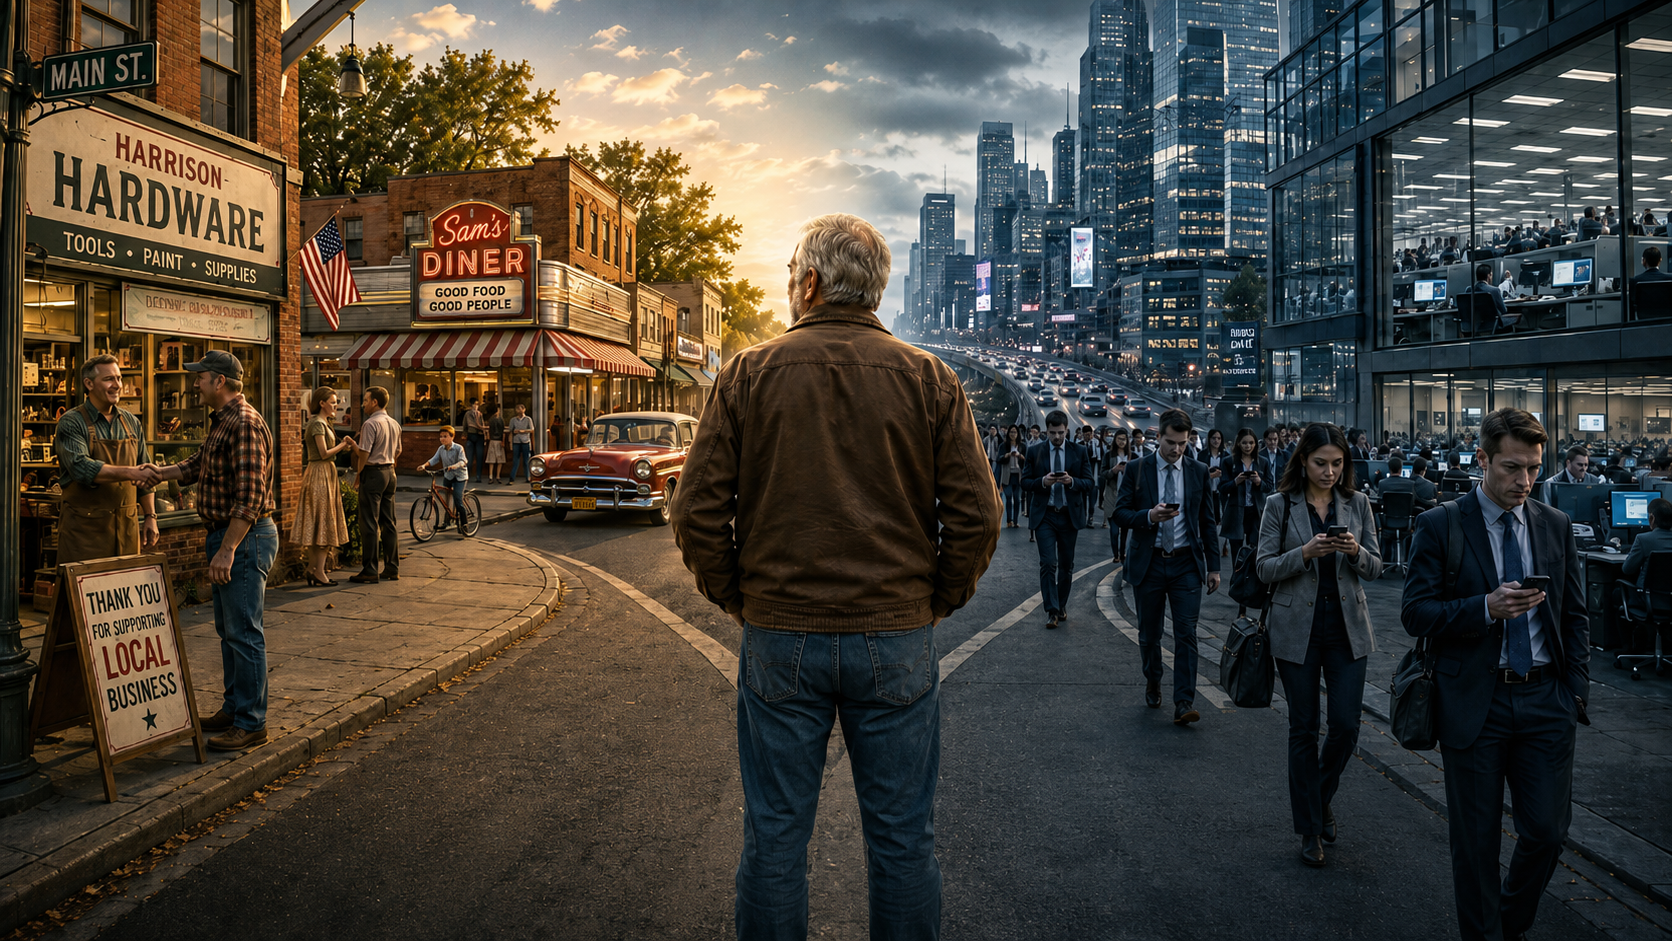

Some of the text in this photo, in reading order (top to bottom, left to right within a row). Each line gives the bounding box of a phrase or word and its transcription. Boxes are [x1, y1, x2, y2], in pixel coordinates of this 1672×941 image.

[51, 52, 147, 91] MAIN ST.
[115, 132, 222, 190] HARRISON
[53, 150, 265, 253] HARDWARE
[438, 214, 509, 246] Sam's
[63, 231, 257, 284] TOOLS PAINT SUPPLIES
[423, 248, 524, 276] DINER
[429, 299, 511, 311] GOOD PEOPLE
[435, 286, 506, 297] GOOD FOOD
[86, 582, 161, 615] THANK YOU
[92, 612, 166, 640] FOR SUPPORTING
[102, 634, 171, 681] LOCAL
[107, 672, 178, 713] BUSINESS
